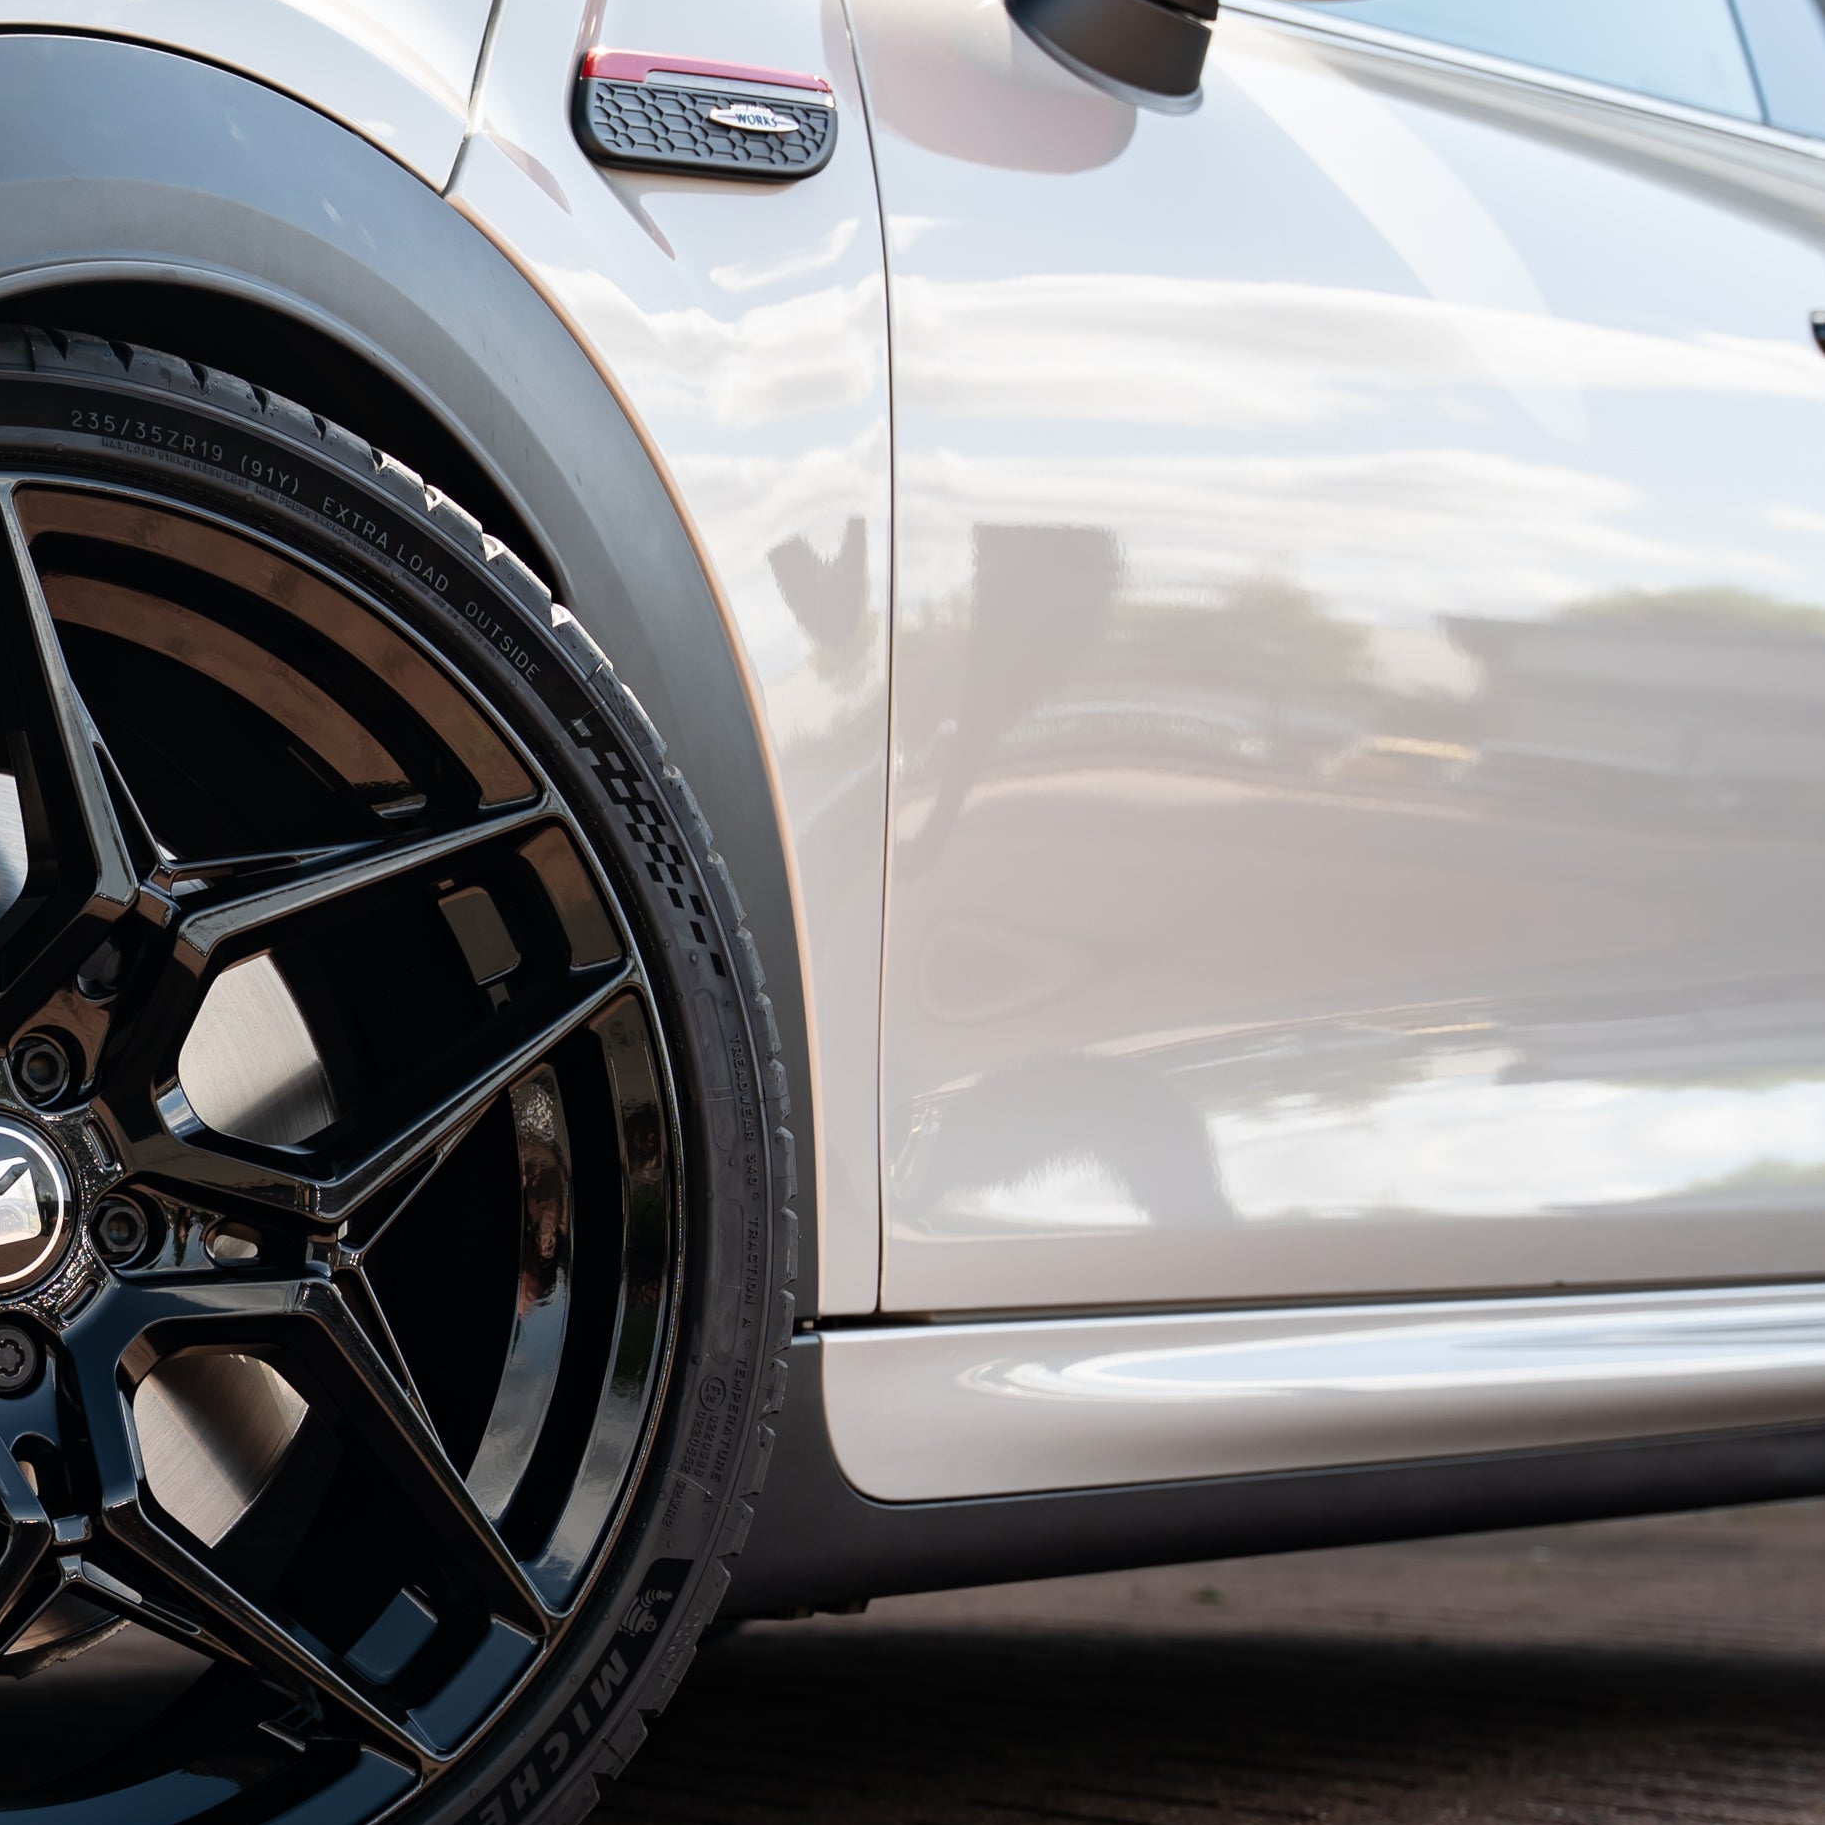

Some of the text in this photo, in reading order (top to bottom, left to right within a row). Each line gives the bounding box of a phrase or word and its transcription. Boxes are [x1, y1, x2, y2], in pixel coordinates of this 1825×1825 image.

[71, 409, 224, 462] 235/35ZR19
[240, 454, 302, 495] (91Y)
[321, 496, 389, 549] EXTRA
[396, 544, 449, 593] LOAD
[464, 601, 540, 682] OUTSIDE
[730, 1033, 757, 1141] TREADWEAR
[748, 1153, 761, 1188] 340
[746, 1216, 761, 1305] TRACTION
[742, 1318, 753, 1328] A
[710, 1358, 750, 1483] TEMPERATURE
